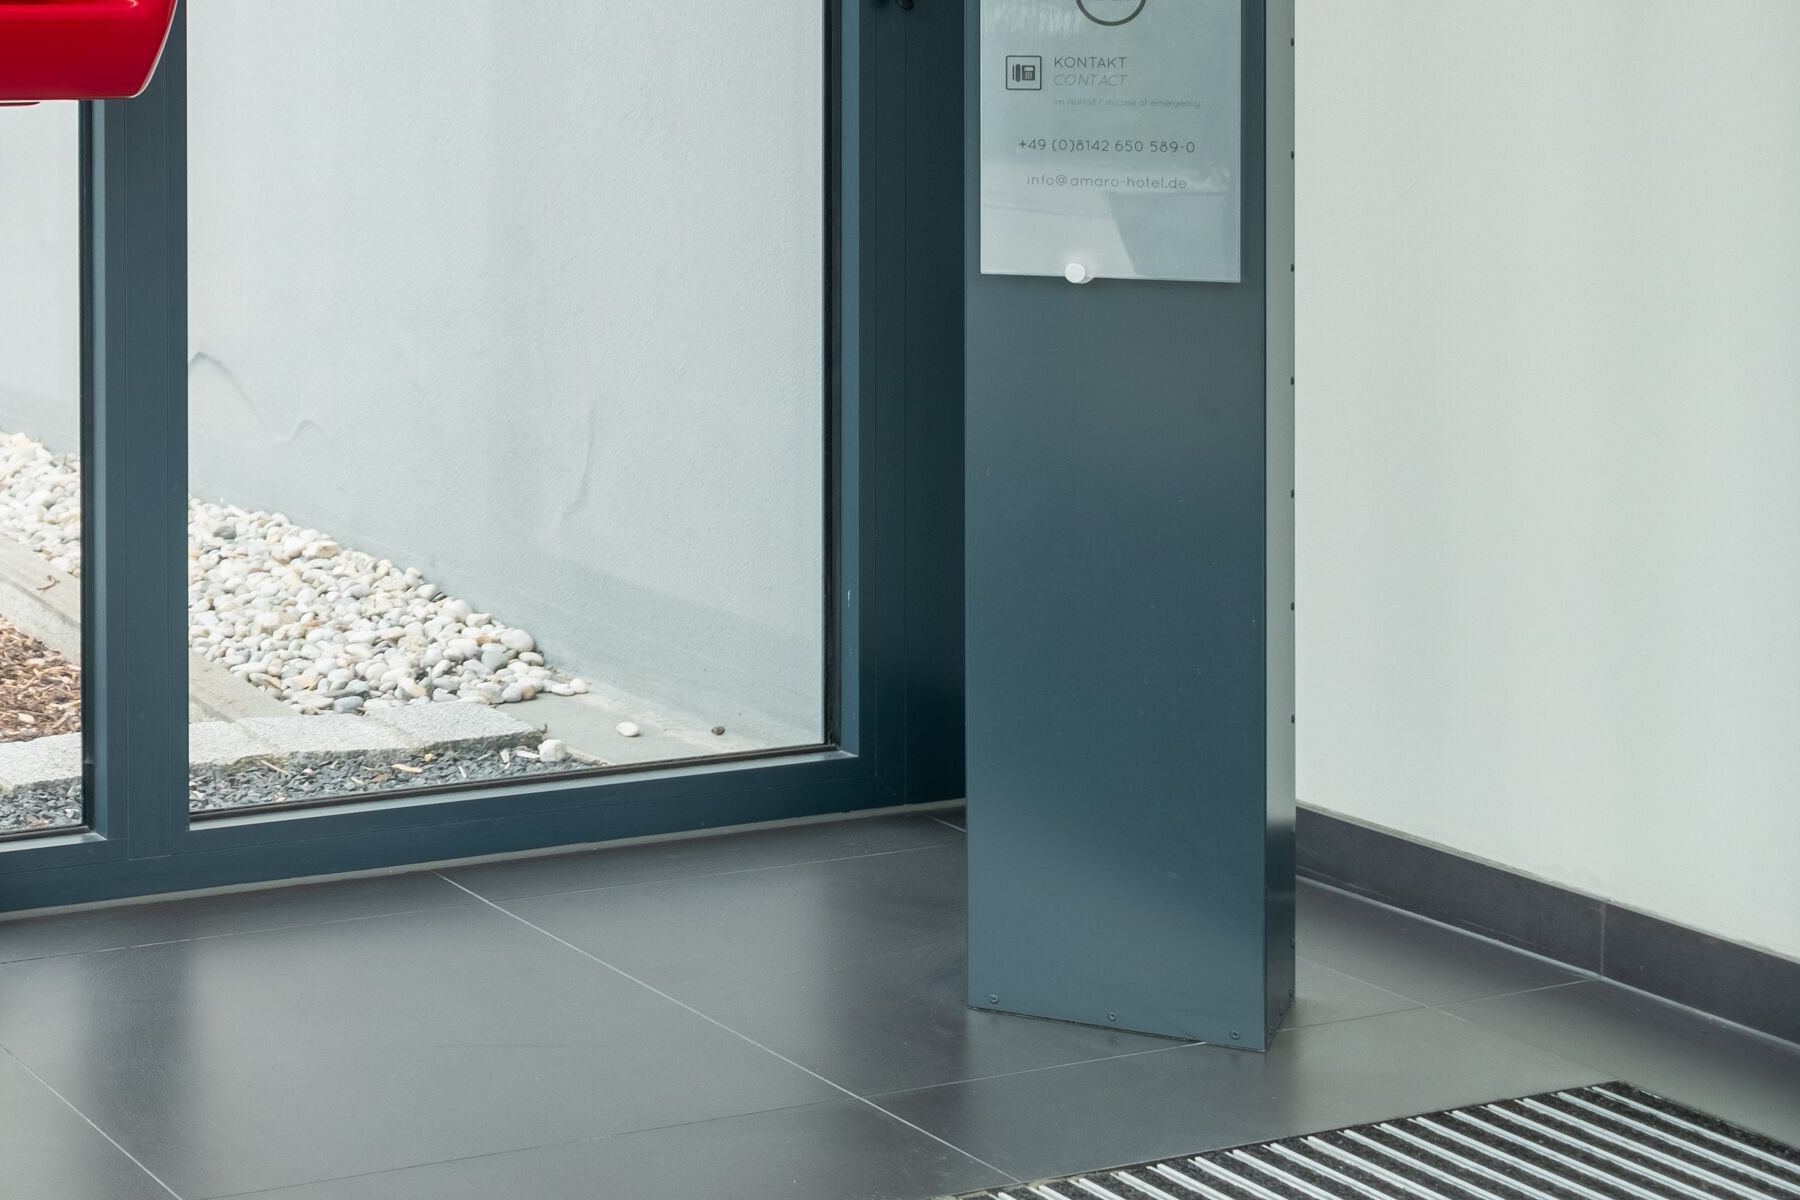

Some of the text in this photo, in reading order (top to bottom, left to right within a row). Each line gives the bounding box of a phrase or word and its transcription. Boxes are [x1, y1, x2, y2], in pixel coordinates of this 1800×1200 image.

[1053, 56, 1127, 69] KONTAKT
[1053, 73, 1129, 87] CONTACT
[1018, 138, 1196, 154] +49 (0)8142 650 589-0
